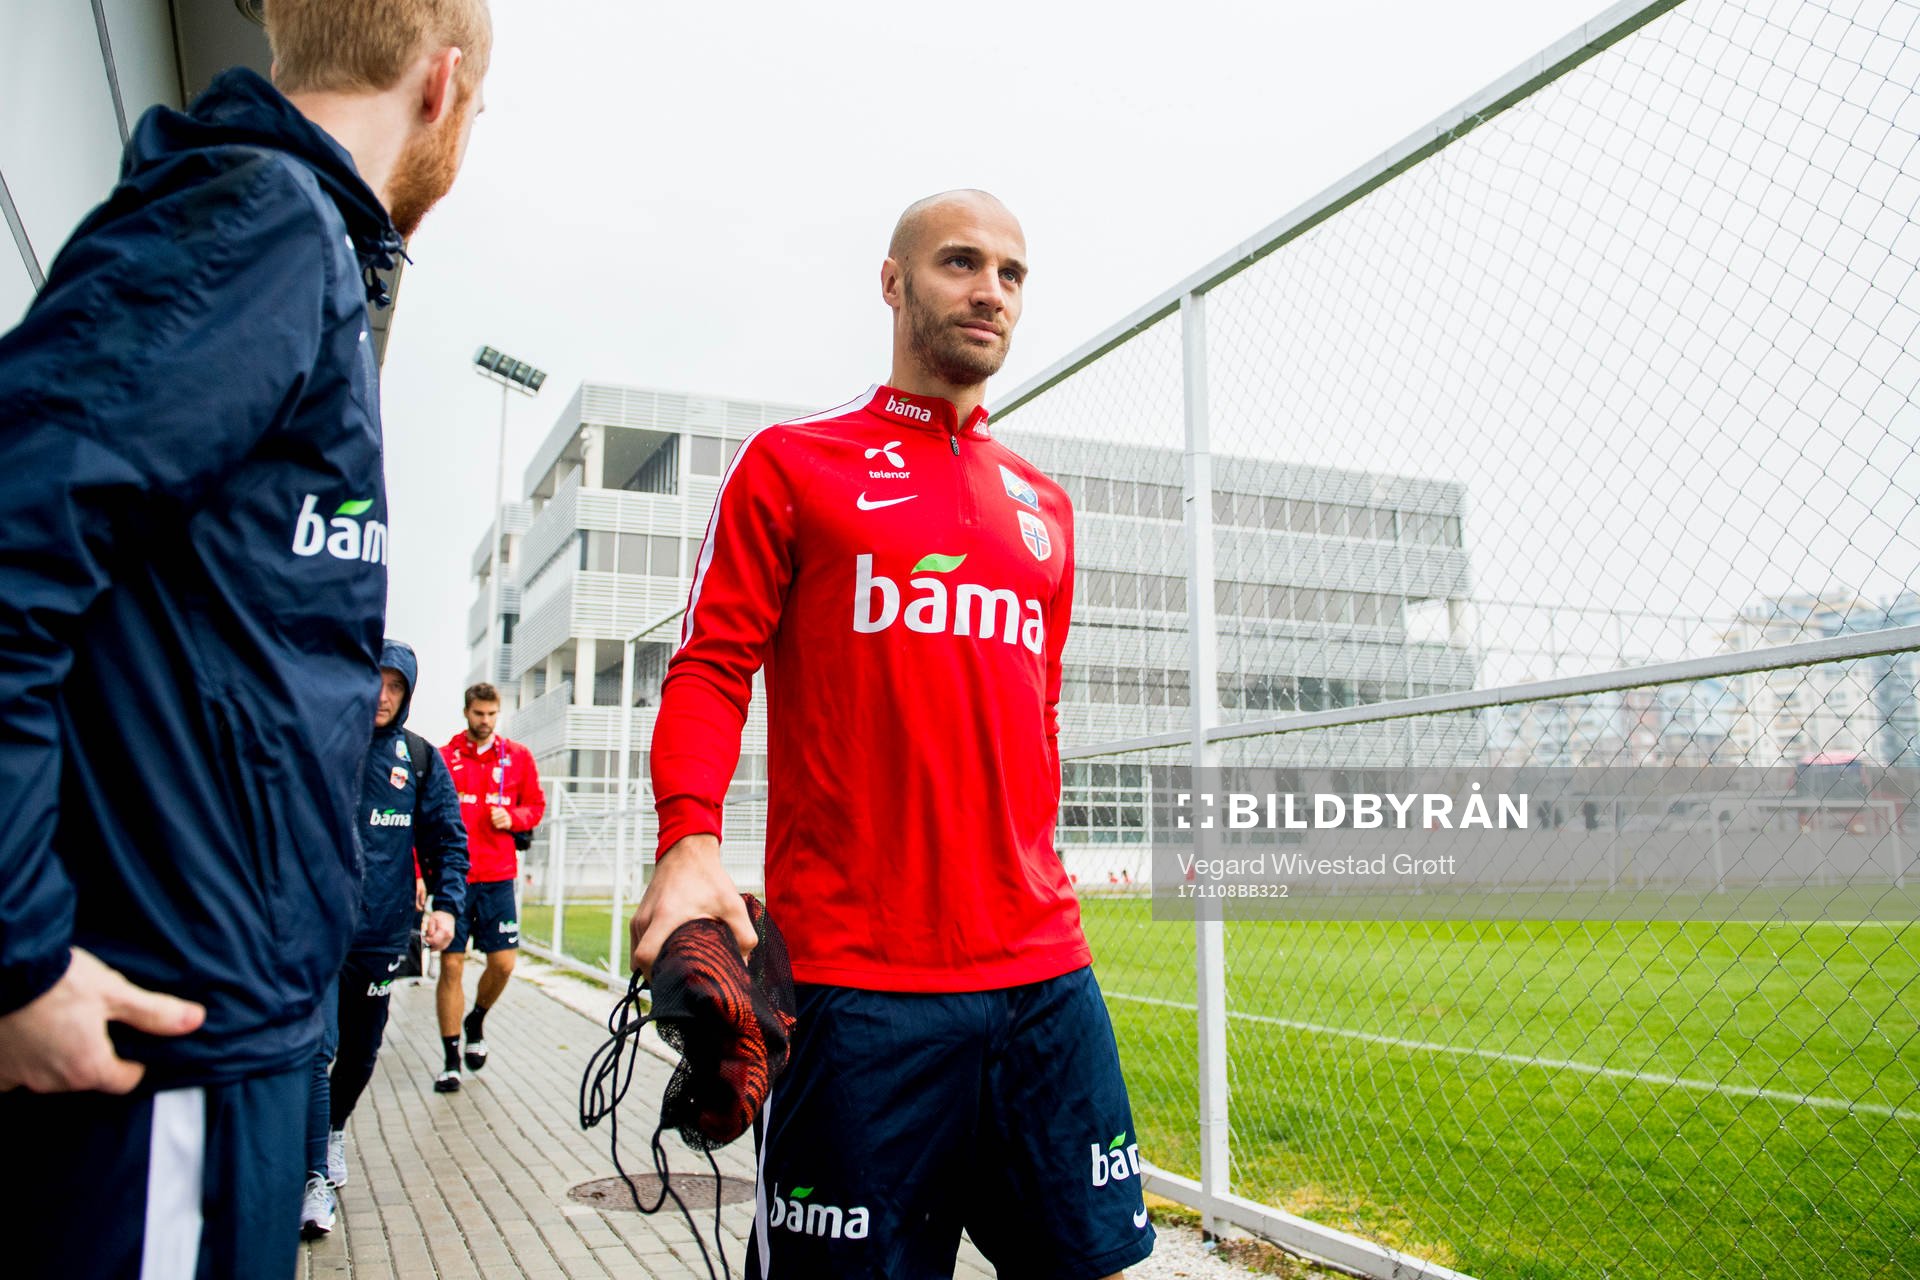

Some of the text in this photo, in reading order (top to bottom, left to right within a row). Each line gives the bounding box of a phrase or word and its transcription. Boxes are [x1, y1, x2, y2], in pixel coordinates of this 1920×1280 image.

[884, 395, 932, 423] bama
[868, 470, 911, 479] telenor
[853, 553, 1045, 655] bama
[370, 808, 412, 827] bama
[769, 1182, 870, 1239] bama
